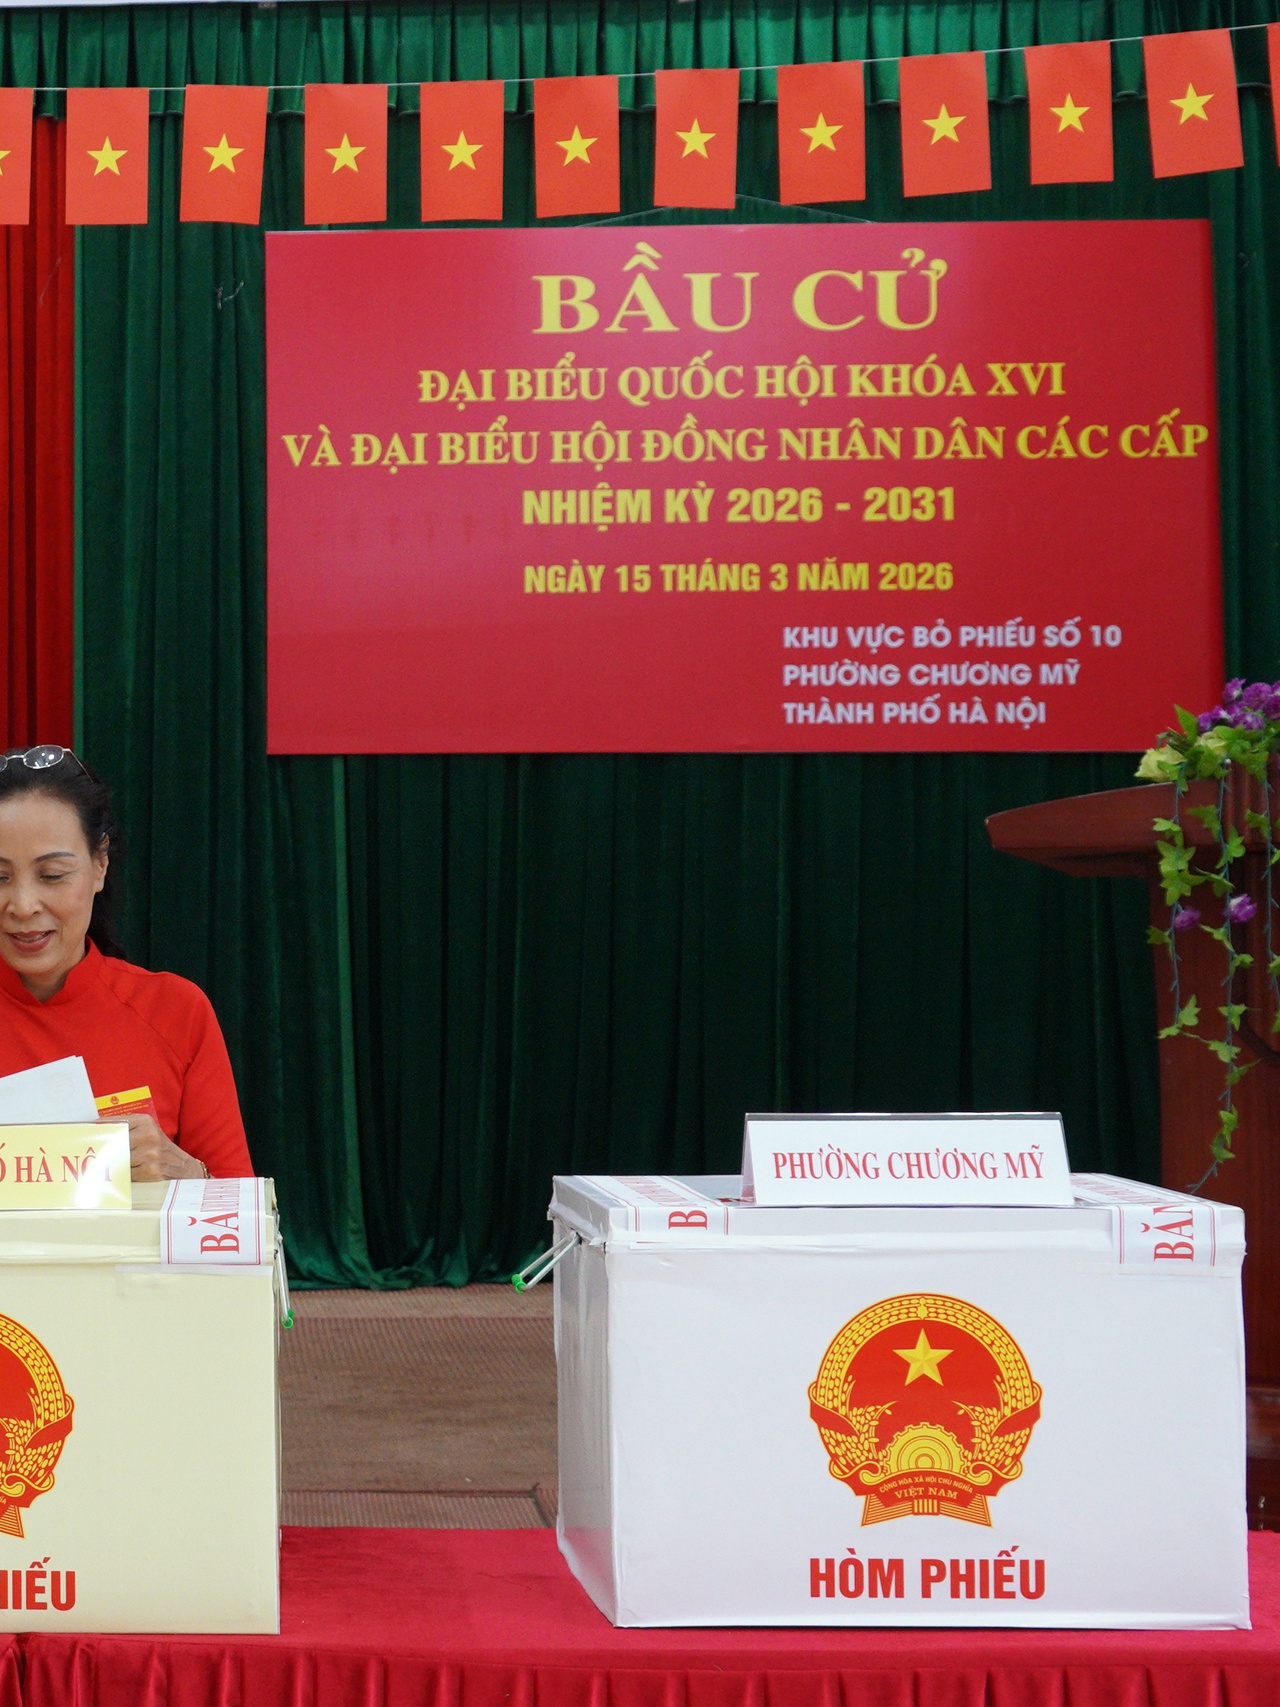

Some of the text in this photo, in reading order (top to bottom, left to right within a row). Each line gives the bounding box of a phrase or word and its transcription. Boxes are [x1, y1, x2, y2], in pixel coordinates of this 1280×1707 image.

[532, 241, 950, 334] BẦU CỬ
[417, 350, 1067, 412] ĐẠI BIỂU QUỐC HỘI KHÓA XVI
[280, 407, 1210, 475] VÀ ĐẠI BIỂU HỘI ĐỒNG NHÂN DÂN CÁC CẤP
[521, 481, 653, 533] NHIỆM
[663, 480, 716, 524] KỲ
[725, 486, 825, 523] 2026
[861, 485, 956, 522] 2031
[522, 556, 955, 594] NGÀY 15 THÁNG 3 NĂM 2026
[782, 616, 1123, 654] KHU VỰC BỎ PHIẾU SỐ 10
[782, 658, 1081, 687] PHƯỜNG CHƯƠNG MỸ
[782, 693, 1047, 729] THÀNH PHỐ HÀ NỘI
[13, 1146, 55, 1183] HÀ
[772, 1143, 1045, 1180] PHƯỜNG CHƯƠNG MỸ
[894, 1486, 958, 1499] VIỆT NAM
[808, 1545, 1047, 1601] HÒM PHIẾU
